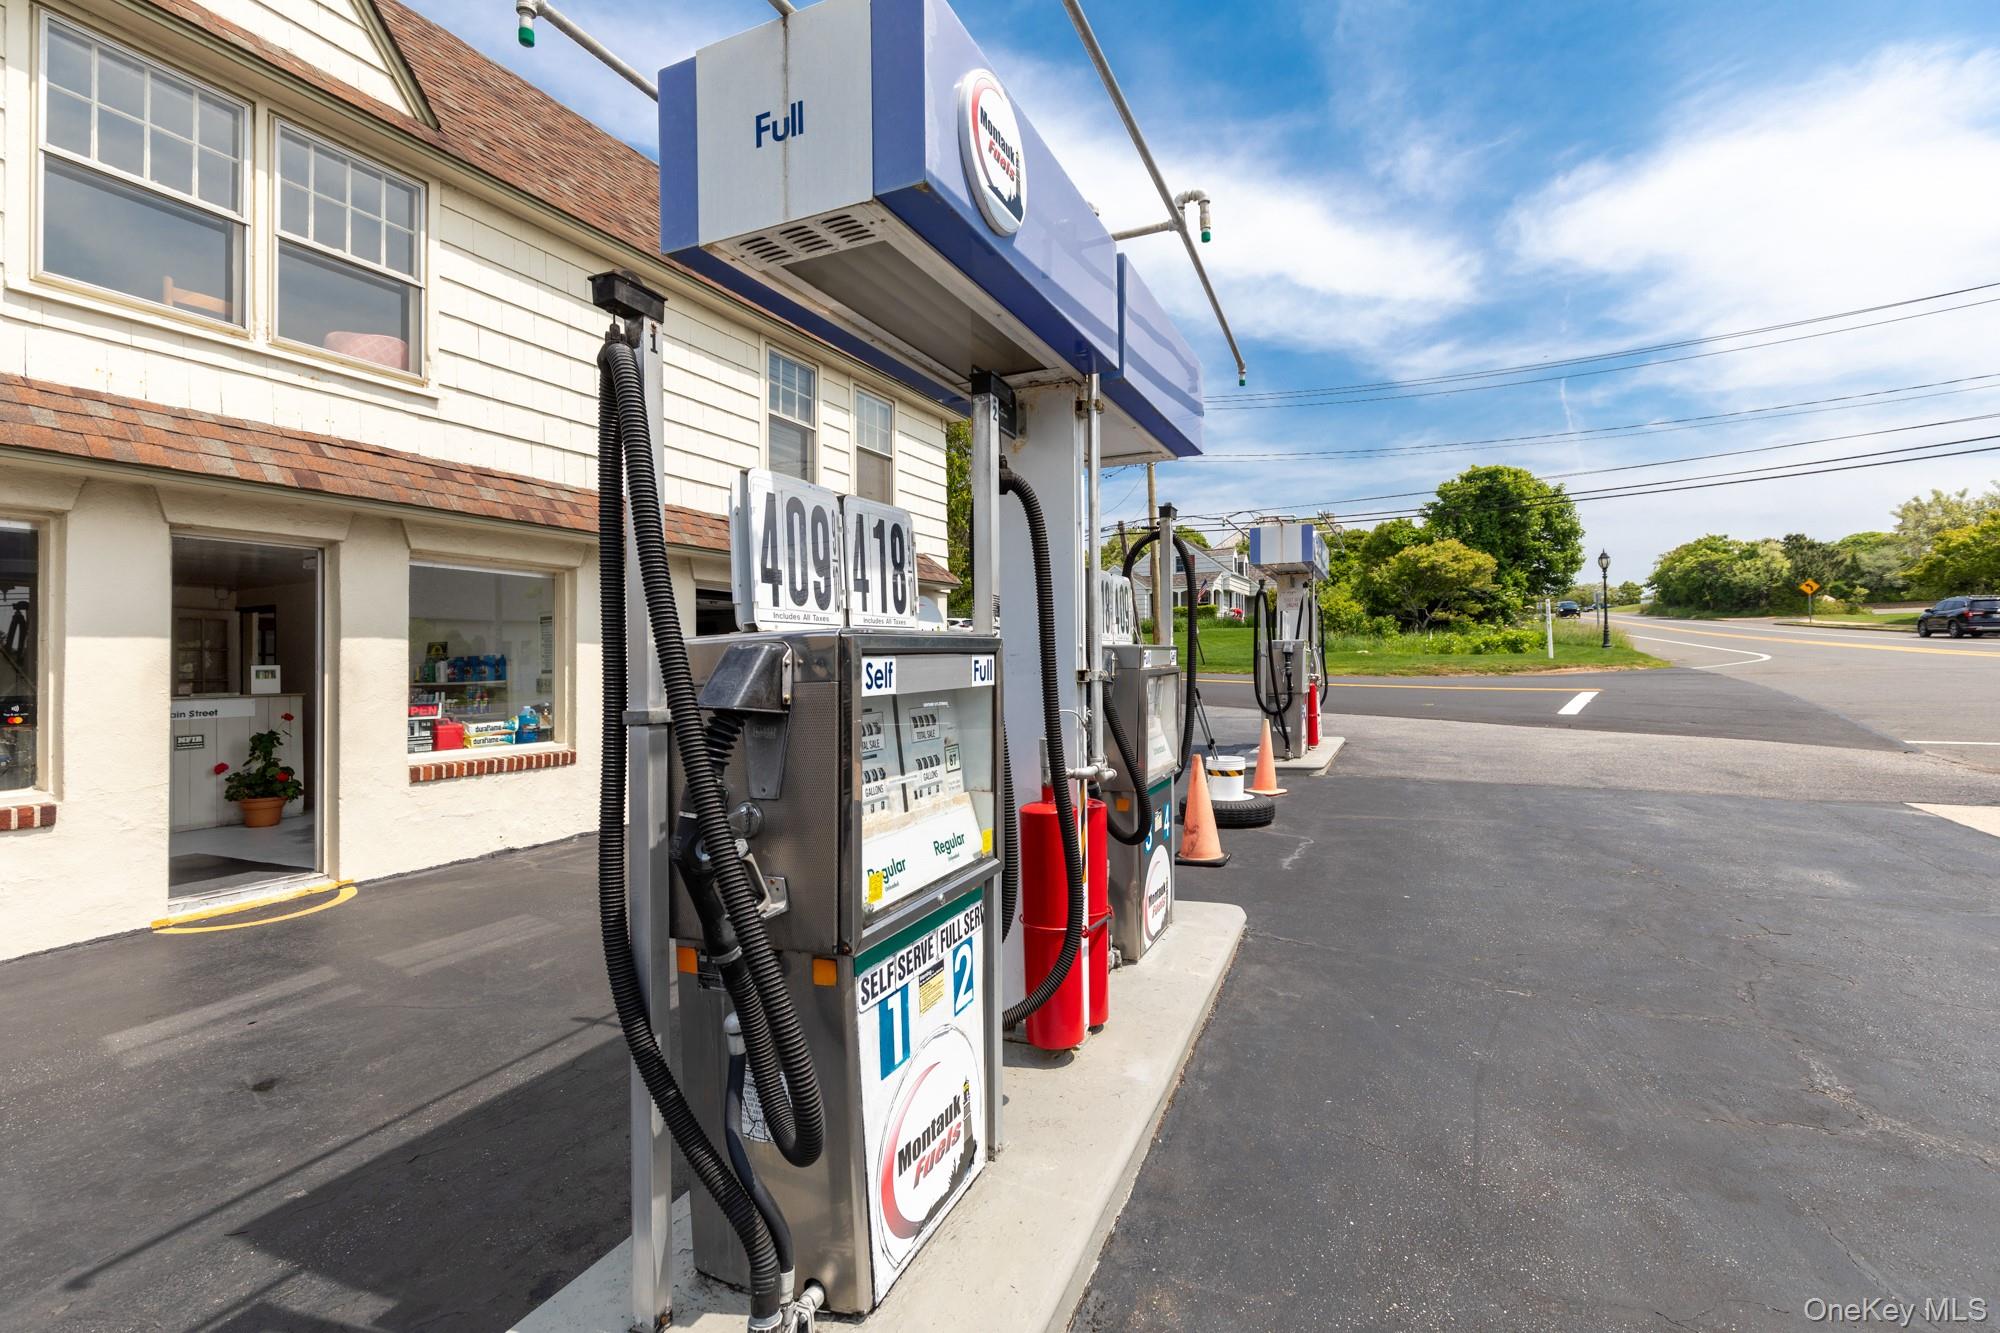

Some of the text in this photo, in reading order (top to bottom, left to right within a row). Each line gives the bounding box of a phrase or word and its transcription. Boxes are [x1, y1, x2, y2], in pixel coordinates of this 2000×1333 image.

[755, 100, 804, 148] Full
[980, 106, 1015, 166] Montauk
[988, 138, 1016, 183] Fuels
[760, 492, 831, 611] 409
[853, 513, 907, 615] 418
[773, 611, 830, 622] Includes All Taxes
[863, 617, 885, 625] Includes
[865, 661, 894, 691] Self
[973, 659, 992, 682] Full
[189, 708, 218, 718] Street
[409, 705, 437, 716] PEN
[473, 736, 500, 745] duraflame
[475, 724, 502, 733] duraflame
[926, 729, 936, 739] SALE
[869, 739, 881, 750] SALE
[923, 770, 939, 782] GALLONS
[864, 784, 884, 797] GALLONS
[1163, 803, 1170, 837] 4
[933, 832, 965, 856] Regular
[867, 857, 906, 884] gular
[1148, 882, 1166, 905] Montauk
[1151, 898, 1166, 919] Fuels
[940, 920, 964, 955] FULL
[861, 960, 896, 1006] SELF
[897, 936, 935, 982] SERVE
[954, 943, 973, 1012] 2
[887, 994, 903, 1066] 1
[897, 1094, 962, 1178] Montauk
[913, 1120, 962, 1190] Fuels
